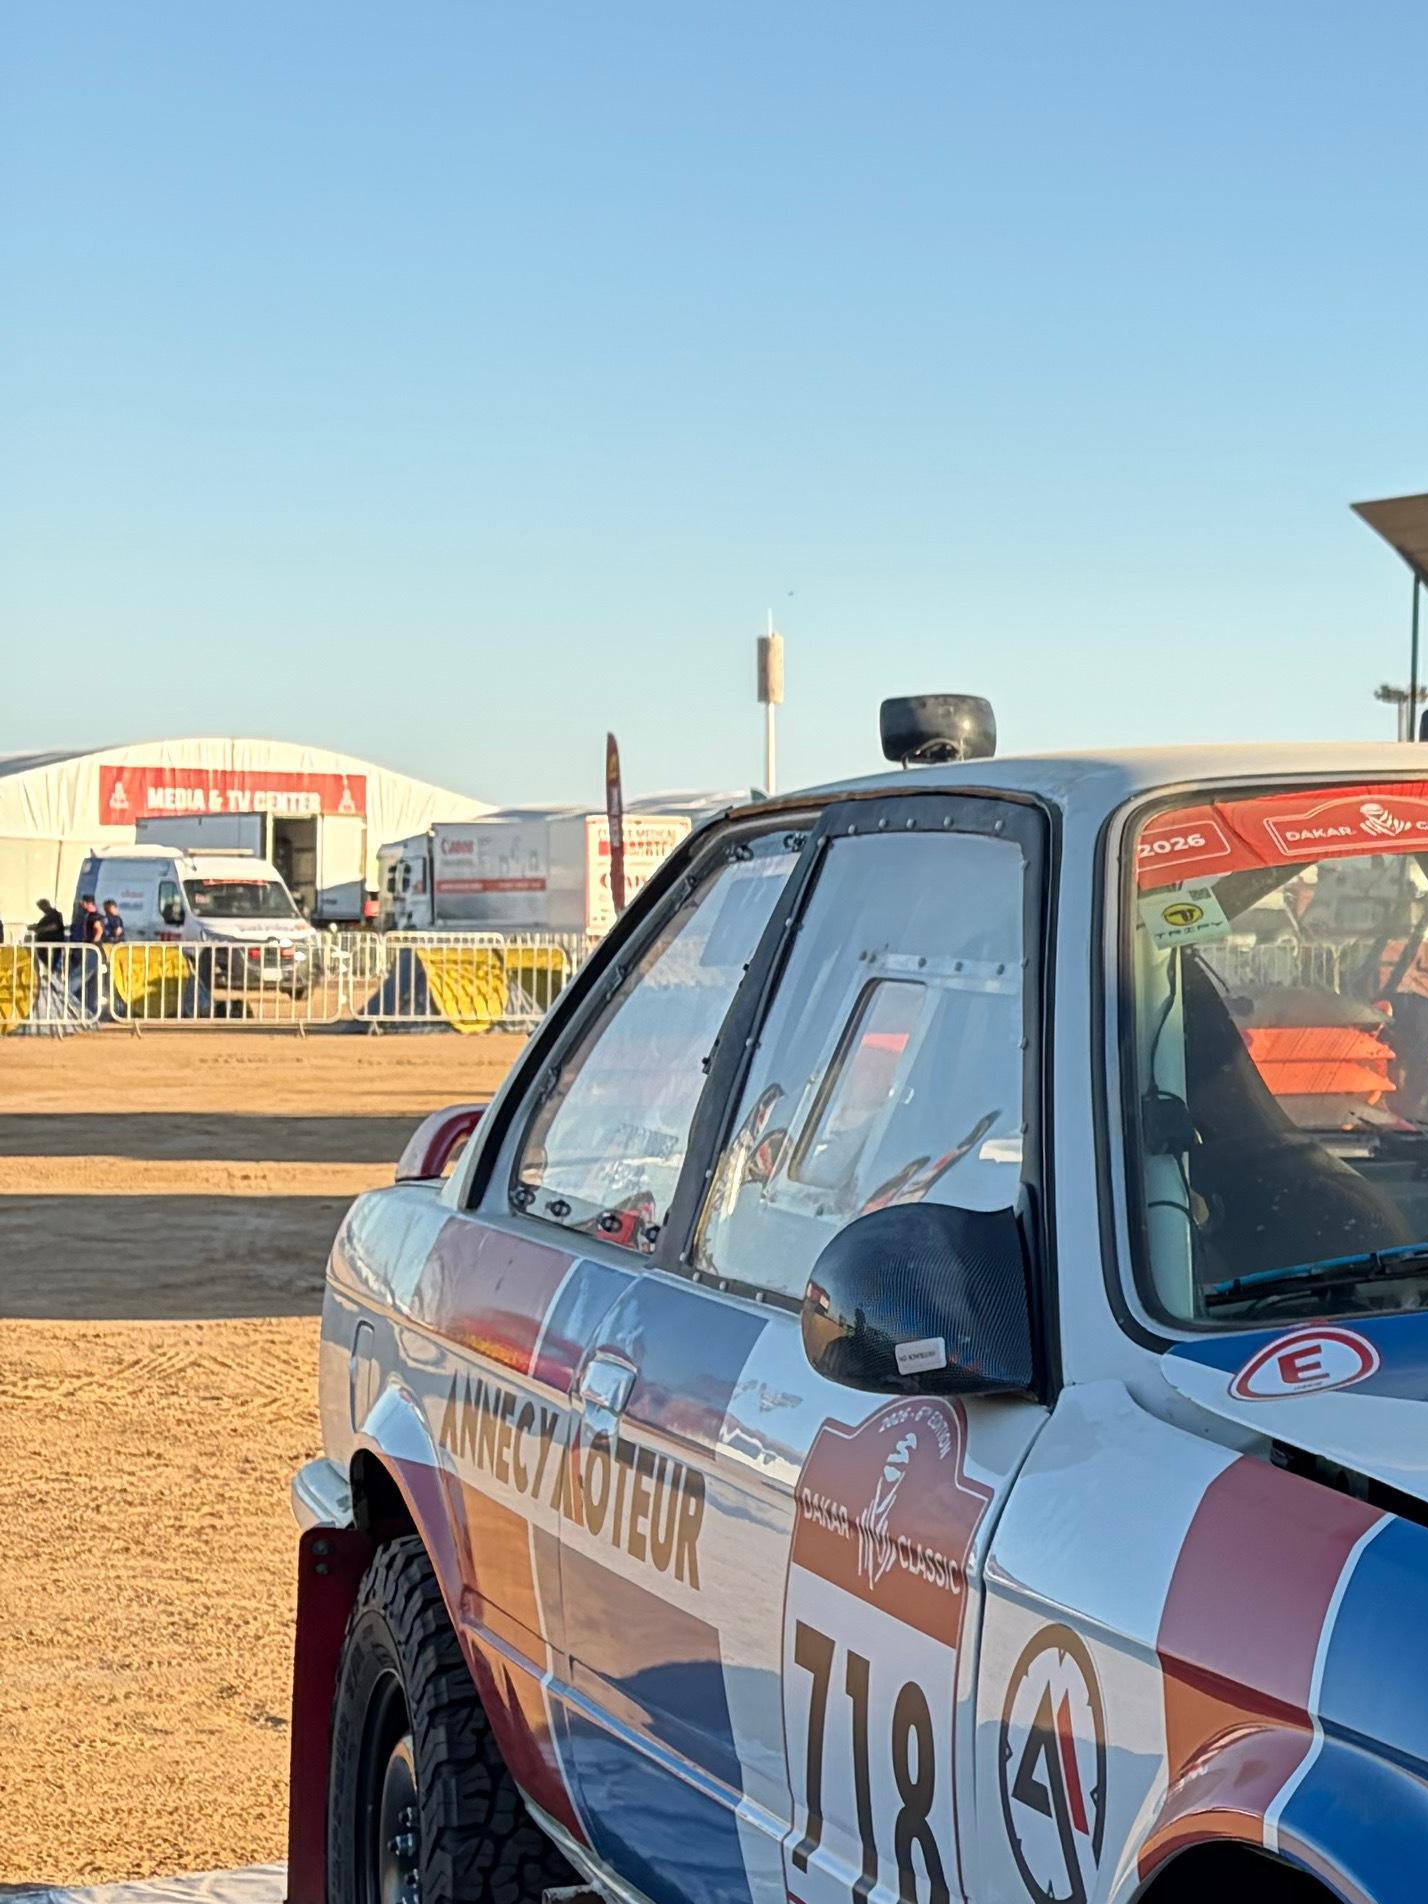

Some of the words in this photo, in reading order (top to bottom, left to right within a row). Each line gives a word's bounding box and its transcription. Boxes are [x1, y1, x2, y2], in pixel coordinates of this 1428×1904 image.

[147, 786, 205, 810] MEDIA
[208, 788, 223, 811] &
[226, 789, 250, 812] TV
[253, 791, 321, 813] CENTER
[1138, 834, 1206, 858] 2026
[1285, 825, 1353, 842] DAKAR
[1277, 1344, 1330, 1384] E
[439, 1368, 559, 1500] ANNECY
[802, 1487, 850, 1540] DAKAR
[898, 1534, 962, 1594] CLASSIC
